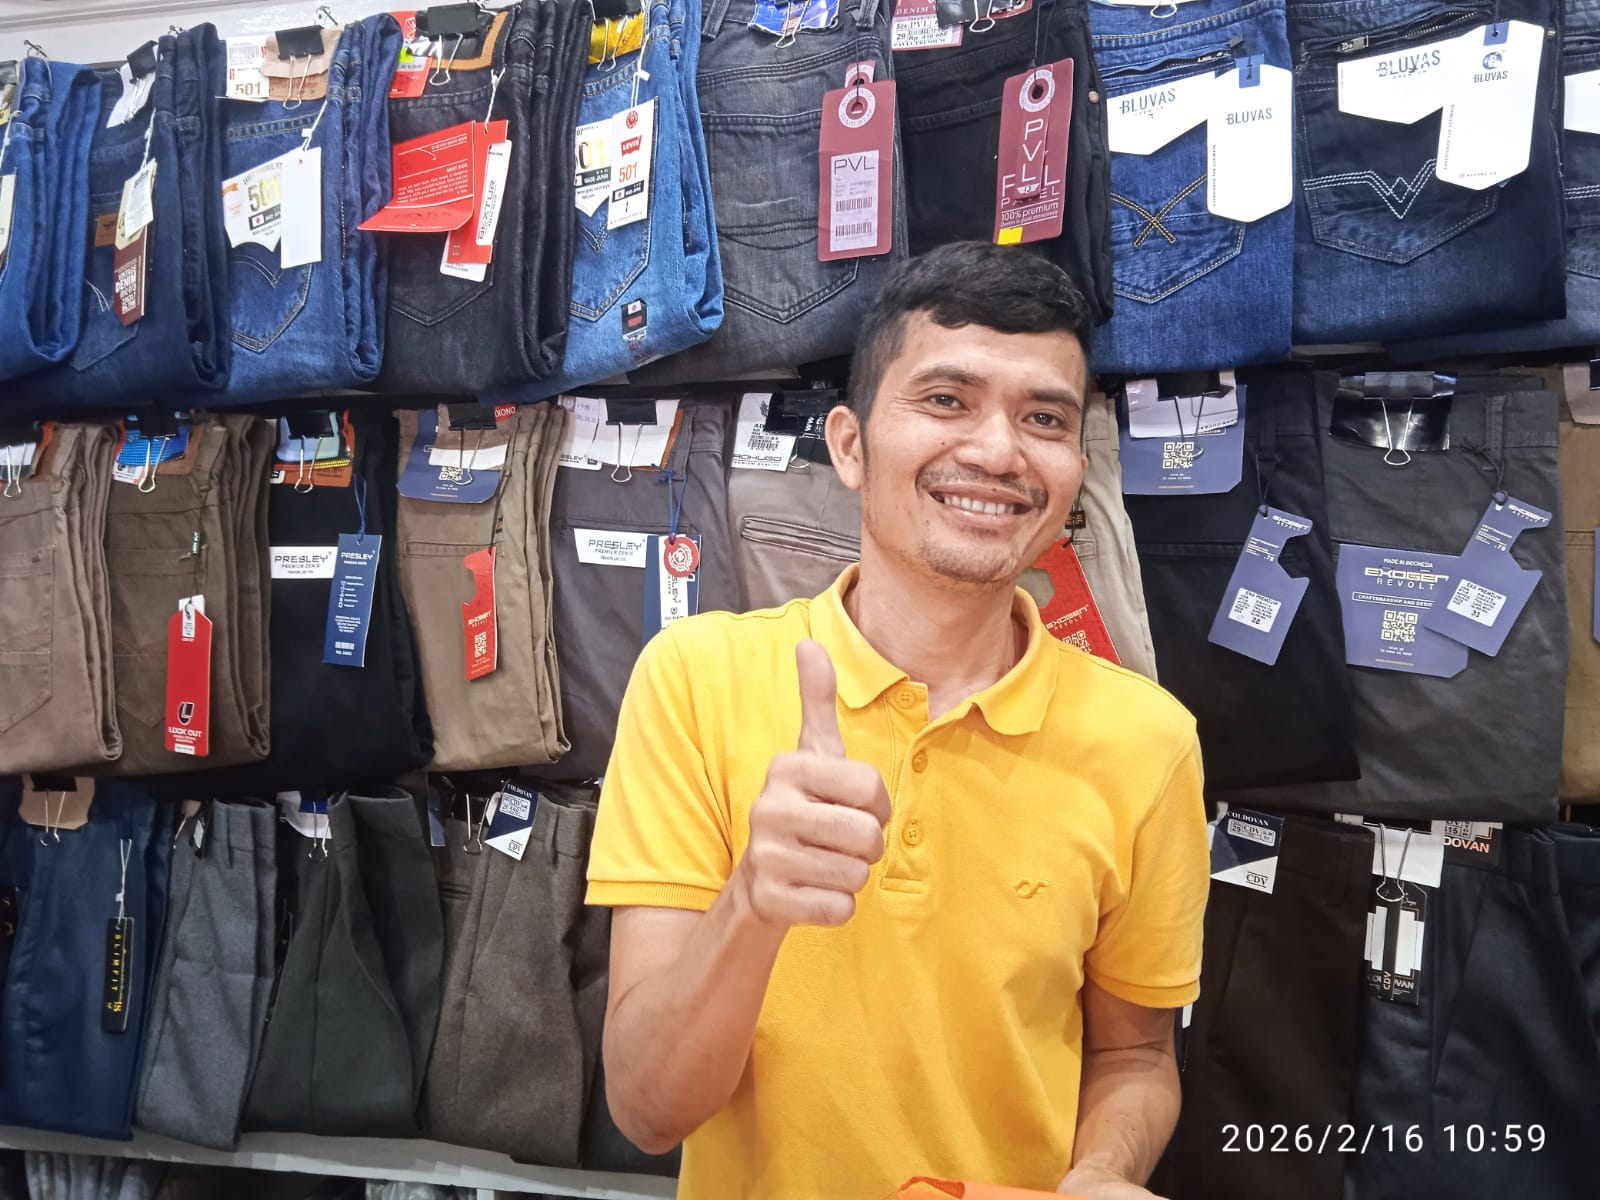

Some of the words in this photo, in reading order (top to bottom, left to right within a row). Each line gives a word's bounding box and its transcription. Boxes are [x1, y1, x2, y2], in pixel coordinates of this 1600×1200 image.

[896, 7, 929, 15] DENIM
[1376, 50, 1441, 78] BLUVAS
[1473, 70, 1508, 83] BLUVAS
[235, 81, 261, 95] 501
[1120, 88, 1176, 114] BLUVAS
[1226, 108, 1273, 125] BLUVAS
[576, 141, 605, 170] 01
[619, 161, 639, 183] 501
[834, 156, 875, 175] PVL
[1001, 211, 1022, 222] 100%
[1022, 201, 1059, 219] premium
[588, 539, 643, 551] PRESLEY
[274, 555, 329, 563] PRESLEY
[341, 551, 374, 560] PRESLEY
[1384, 557, 1399, 565] MADE
[1405, 560, 1433, 569] INDONESIA
[1376, 578, 1435, 590] REVOLT
[1358, 594, 1403, 605] CRAFTSMANSHIP
[168, 726, 188, 735] LOOK
[188, 729, 202, 738] OUT
[507, 783, 533, 799] COLDOVAN
[1443, 836, 1490, 854] DOVAN
[1246, 873, 1268, 886] CDV
[1383, 971, 1392, 991] CDV
[1394, 979, 1415, 990] VAN
